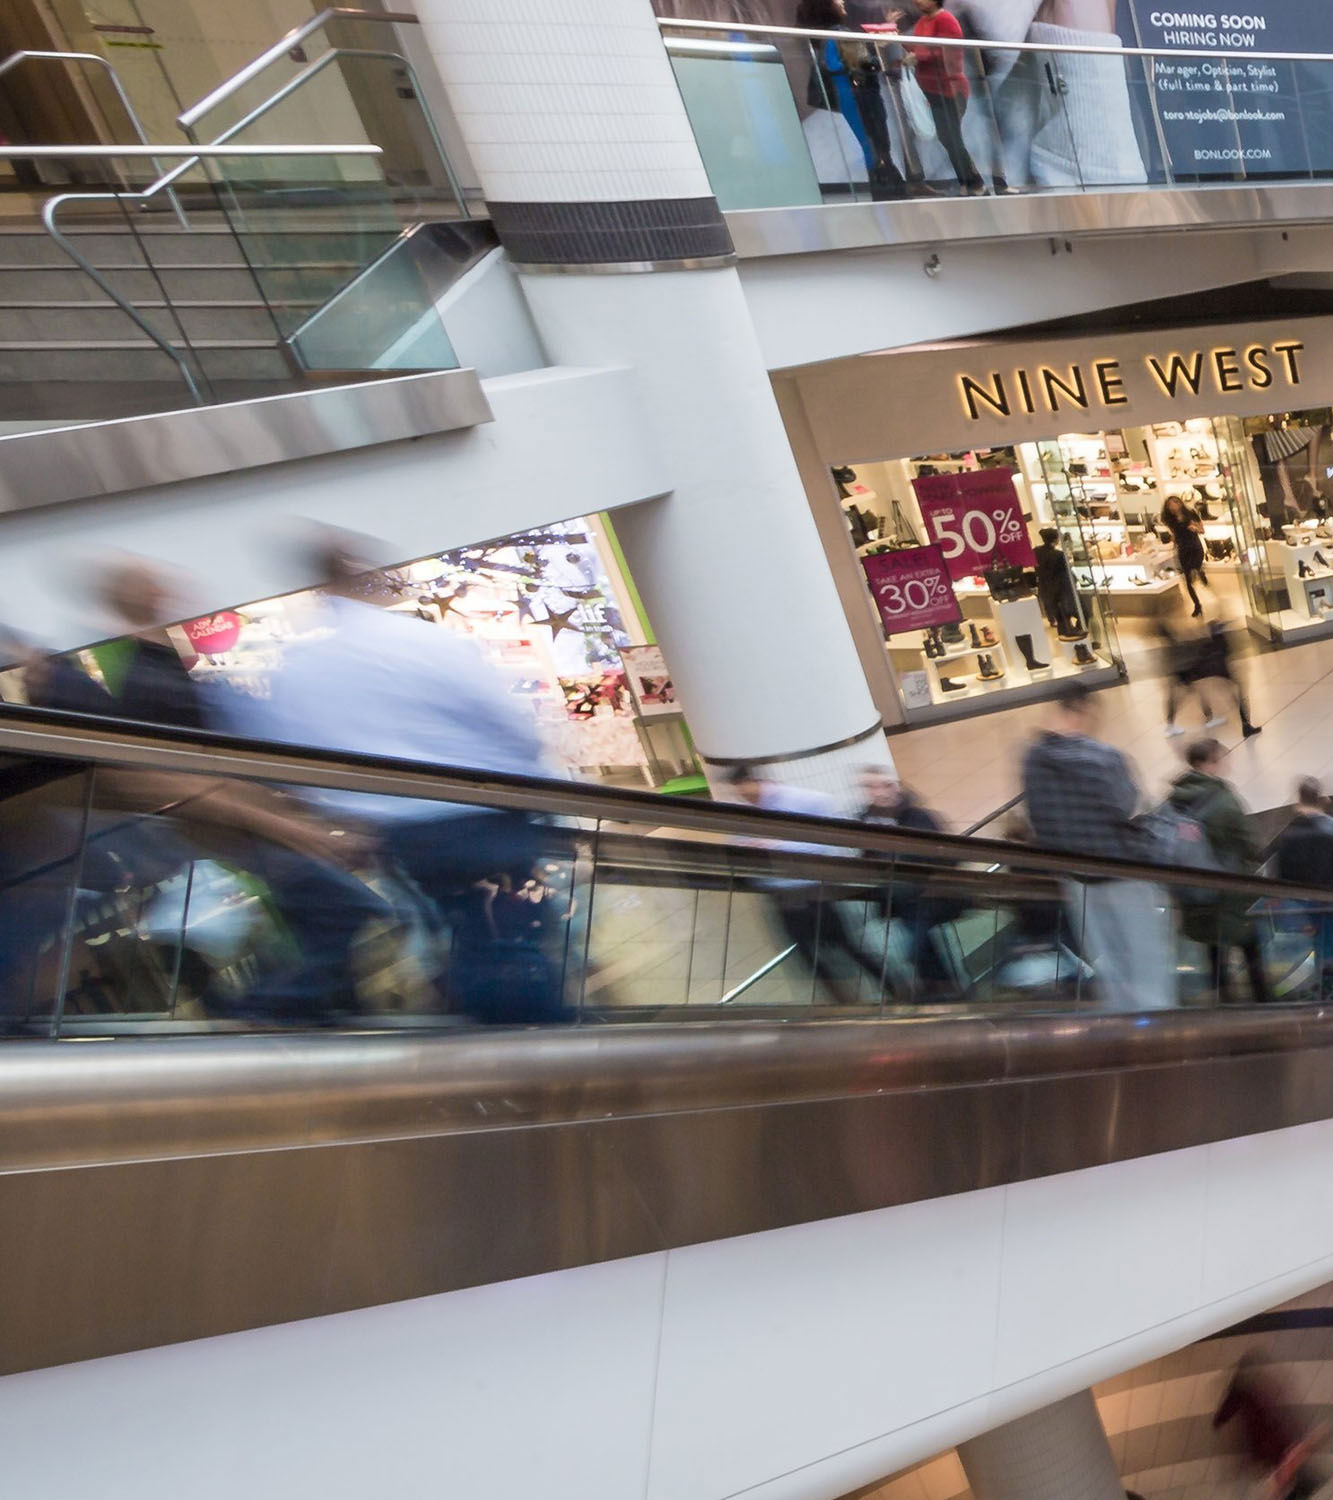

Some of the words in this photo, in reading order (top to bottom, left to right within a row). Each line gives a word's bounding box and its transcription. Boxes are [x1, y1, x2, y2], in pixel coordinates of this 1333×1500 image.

[1150, 12, 1217, 29] COMING
[1220, 14, 1266, 30] SOON
[1164, 31, 1217, 46] HIRING
[1219, 33, 1255, 47] NOW
[1247, 64, 1277, 79] Stylist
[1158, 78, 1182, 91] (full
[1186, 81, 1210, 91] time
[1213, 81, 1223, 91] &
[1226, 82, 1248, 94] part
[1250, 81, 1279, 93] time)
[1194, 149, 1271, 160] BONLOOK.COM
[961, 360, 1128, 420] NINE
[1149, 344, 1304, 399] WEST
[931, 507, 1020, 559] 50%
[1000, 532, 1022, 543] OFF
[880, 575, 947, 614] 30%
[930, 594, 950, 607] OFF
